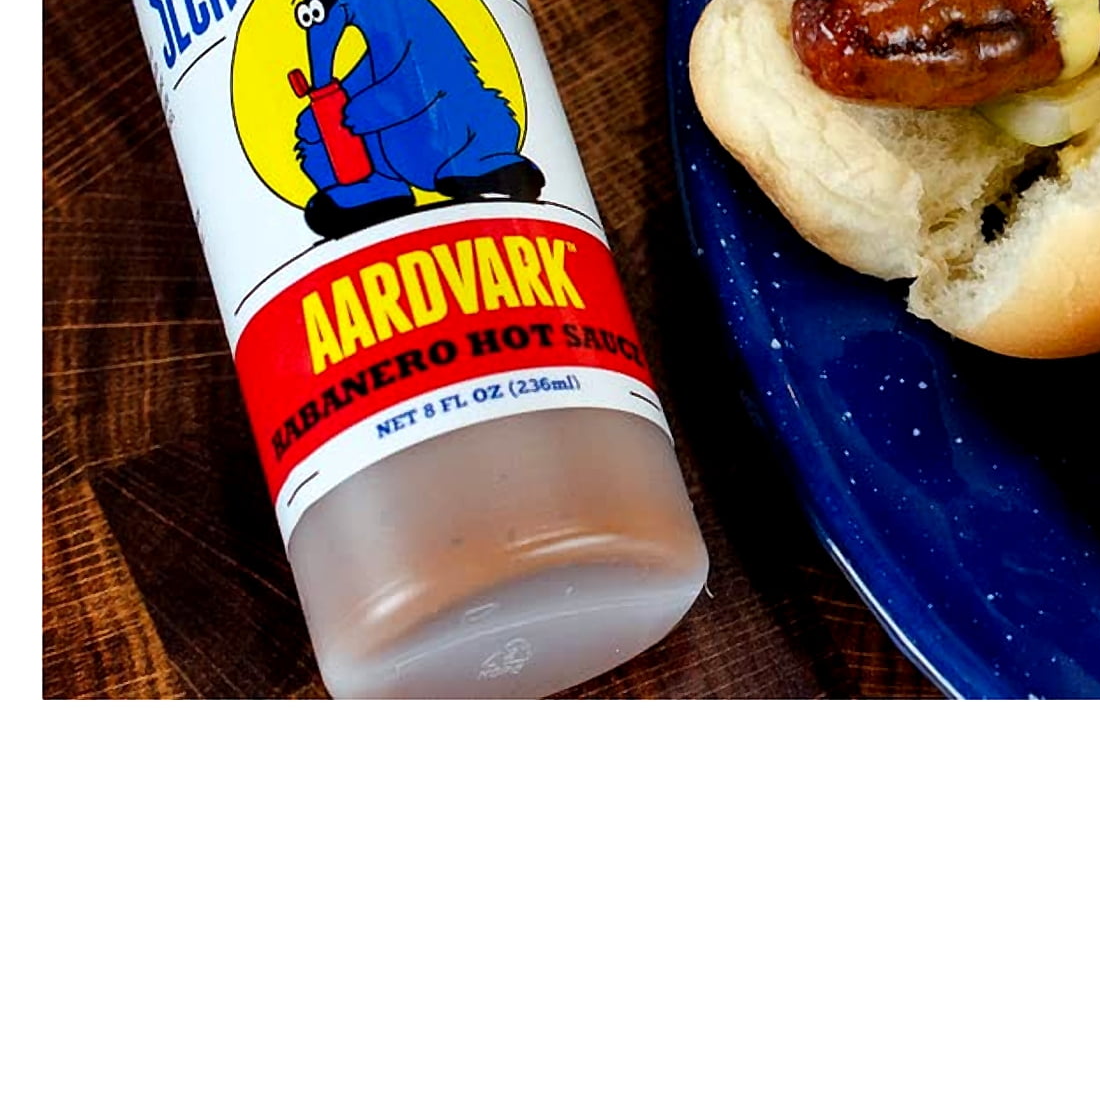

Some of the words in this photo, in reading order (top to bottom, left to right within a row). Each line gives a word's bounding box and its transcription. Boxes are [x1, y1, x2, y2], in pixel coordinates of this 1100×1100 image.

[271, 339, 460, 463] HABANERO
[466, 323, 554, 357] HOT
[373, 407, 418, 440] NET
[422, 402, 437, 419] 8
[439, 393, 469, 415] FL
[471, 383, 504, 404] OZ
[507, 374, 581, 399] (236ml)
